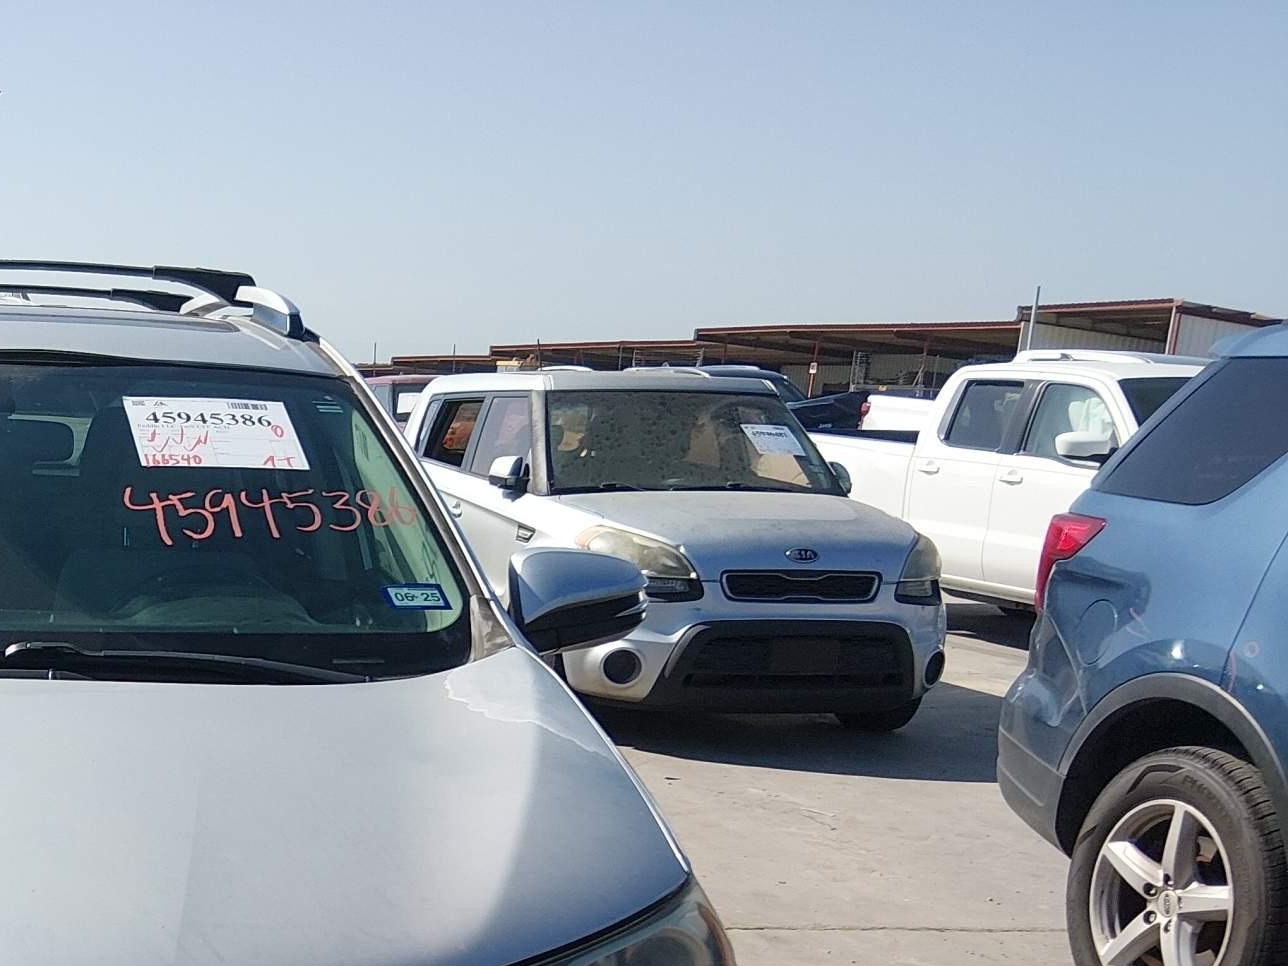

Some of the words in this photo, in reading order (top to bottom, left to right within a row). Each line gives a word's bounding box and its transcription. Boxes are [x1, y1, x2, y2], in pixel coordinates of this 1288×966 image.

[146, 411, 273, 428] 45945386
[144, 453, 203, 467] 166540
[124, 486, 417, 546] 45945386
